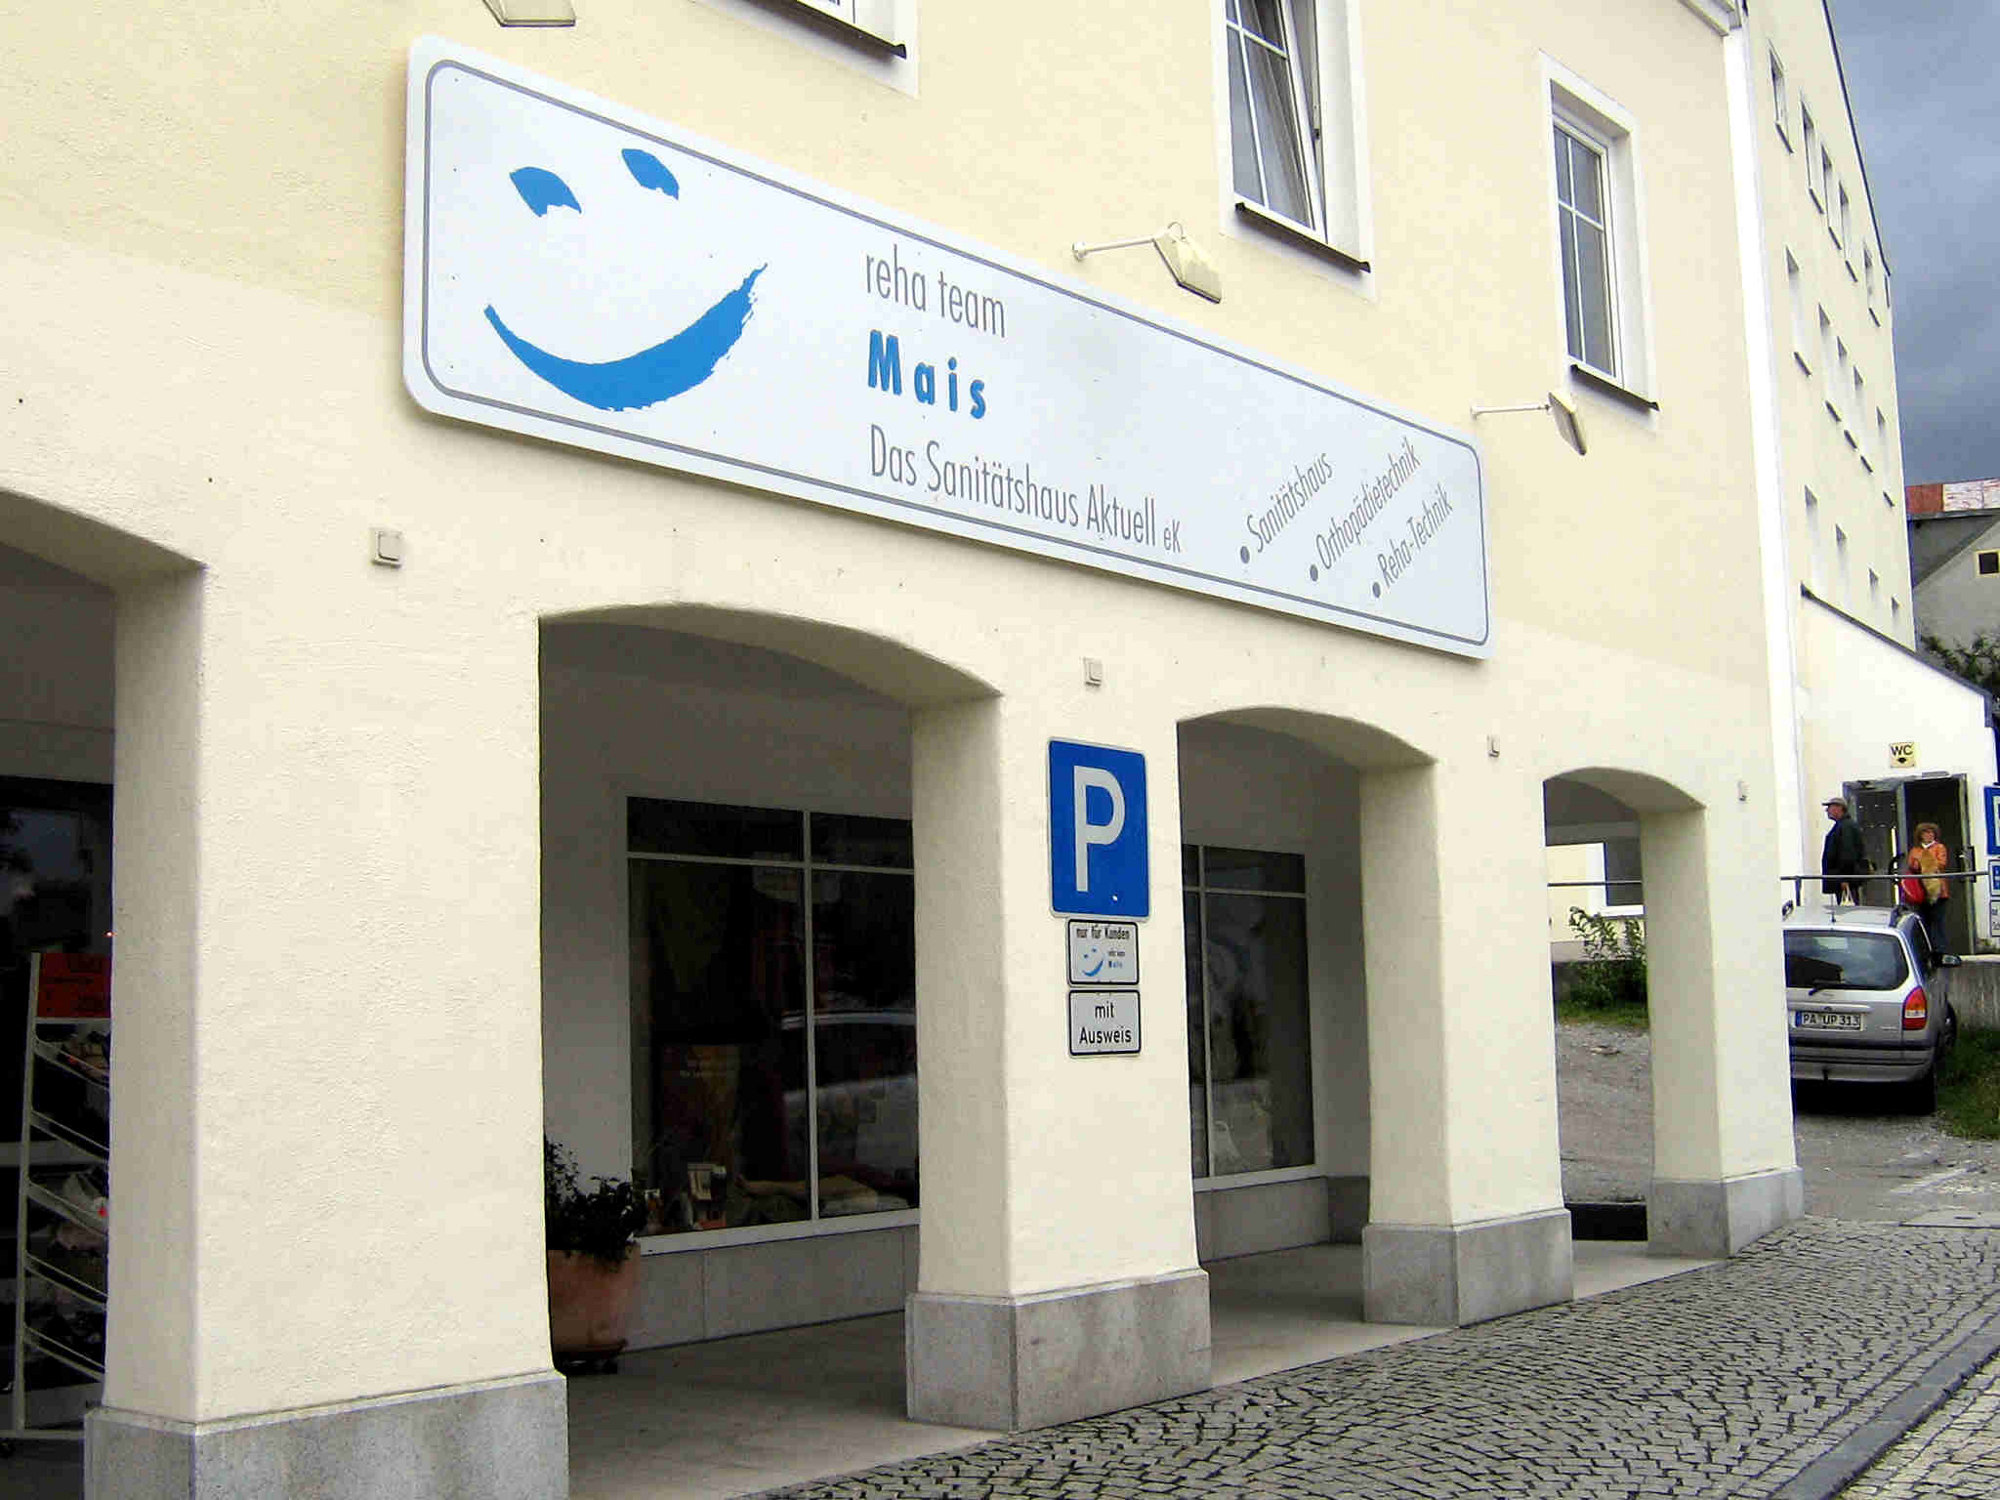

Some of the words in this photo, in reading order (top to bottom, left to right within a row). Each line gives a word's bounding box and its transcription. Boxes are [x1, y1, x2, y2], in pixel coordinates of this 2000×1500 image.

[866, 244, 926, 312] reha
[938, 271, 1005, 338] team
[868, 329, 986, 419] Mais
[871, 424, 917, 486] Das
[926, 440, 1079, 527] Sanitätshaus
[1086, 484, 1156, 547] Aktuell
[1163, 518, 1181, 553] eK
[1247, 453, 1333, 553] Sanitätshaus
[1316, 436, 1421, 570] Orthopädietechnik
[1378, 482, 1453, 588] Reha-Technik
[1890, 744, 1913, 757] WC
[1073, 765, 1125, 892] P
[1079, 1026, 1132, 1045] Ausweis
[1094, 1001, 1115, 1019] mit
